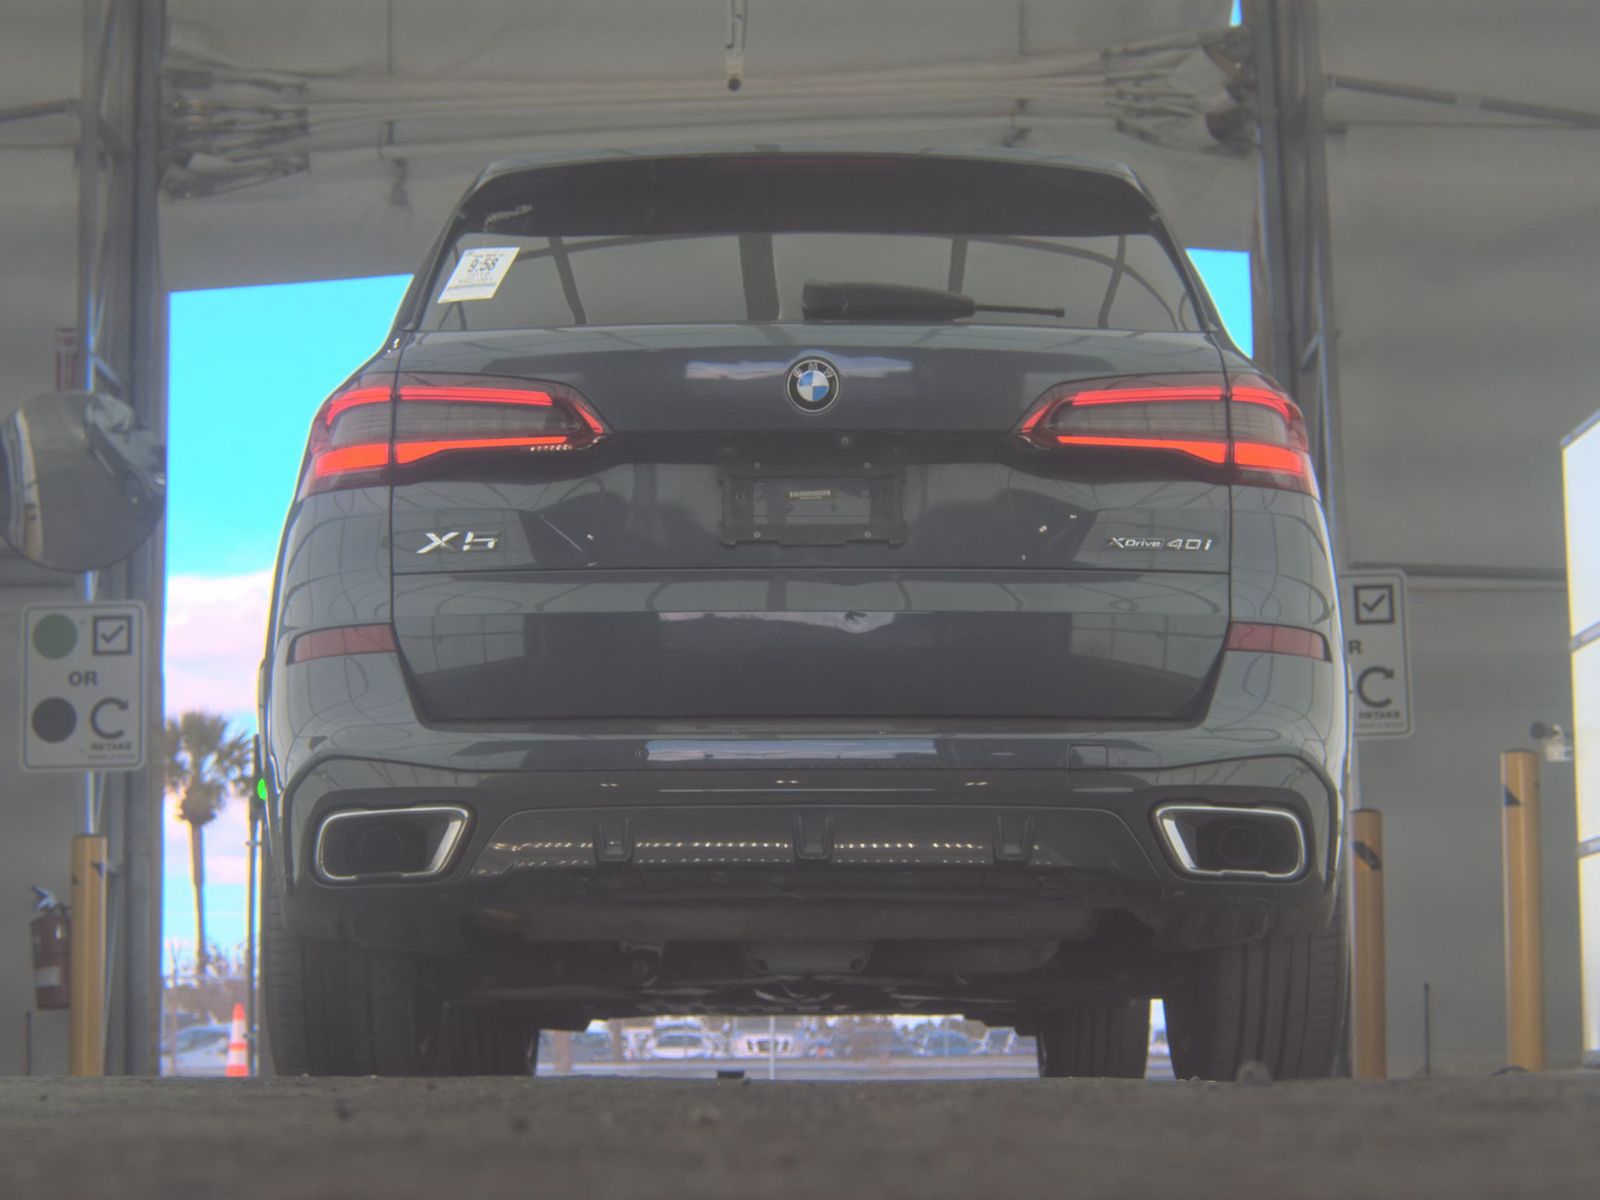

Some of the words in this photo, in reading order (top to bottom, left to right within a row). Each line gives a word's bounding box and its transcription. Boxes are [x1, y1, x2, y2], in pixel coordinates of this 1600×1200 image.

[792, 361, 834, 379] BMW
[415, 530, 501, 554] X5
[1348, 639, 1362, 655] R
[68, 670, 98, 687] OR
